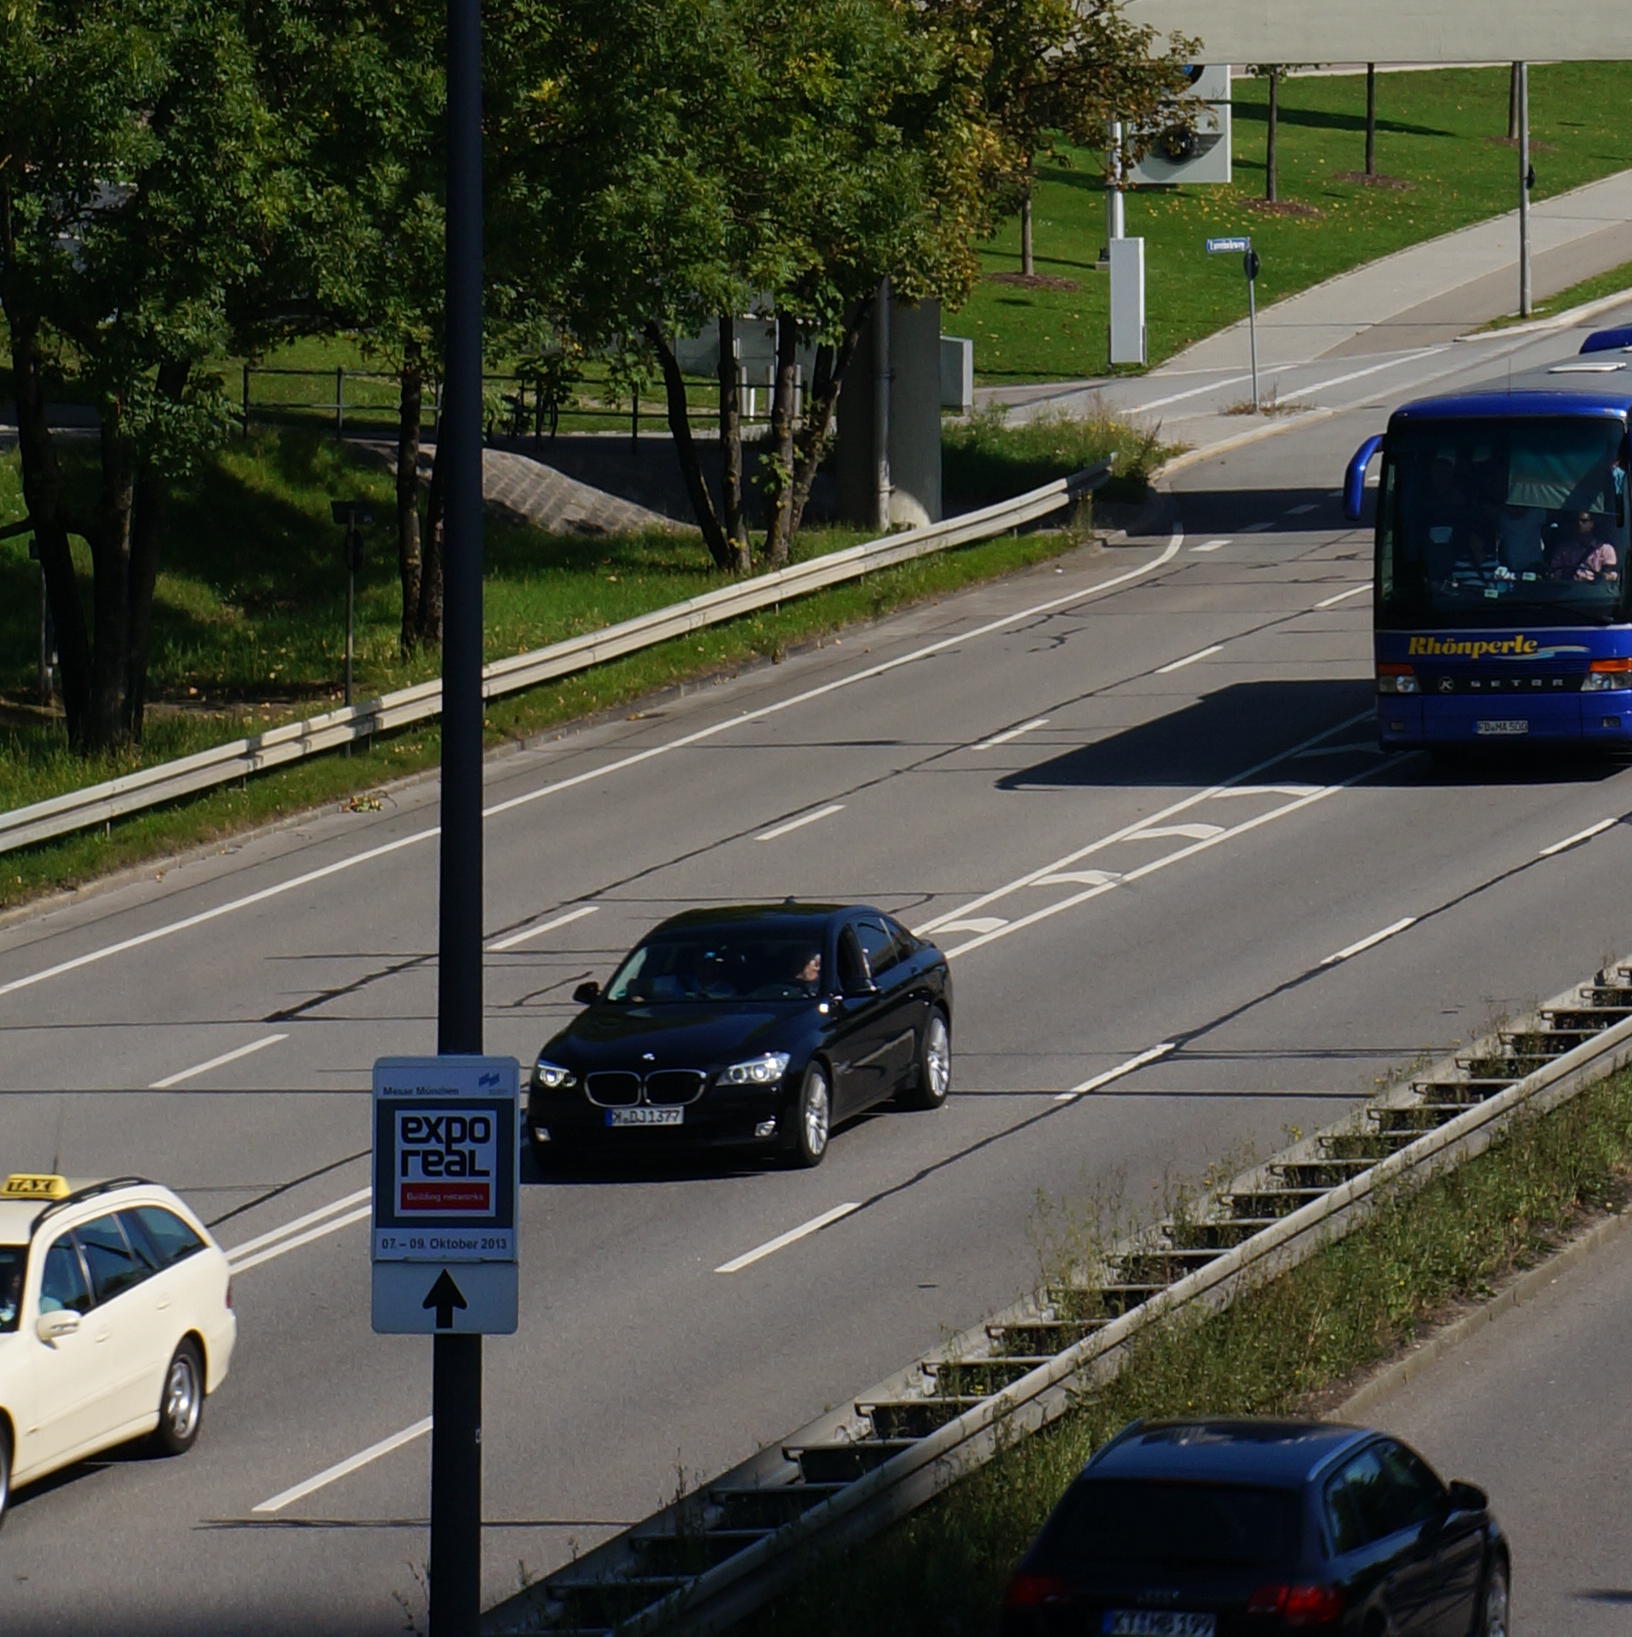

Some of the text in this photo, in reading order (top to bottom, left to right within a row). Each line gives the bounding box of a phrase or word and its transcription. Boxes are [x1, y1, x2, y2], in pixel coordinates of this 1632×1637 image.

[1408, 635, 1538, 659] Rhönperle
[401, 1116, 491, 1156] expo
[430, 1237, 478, 1249] Oktober
[481, 1238, 507, 1249] 2013
